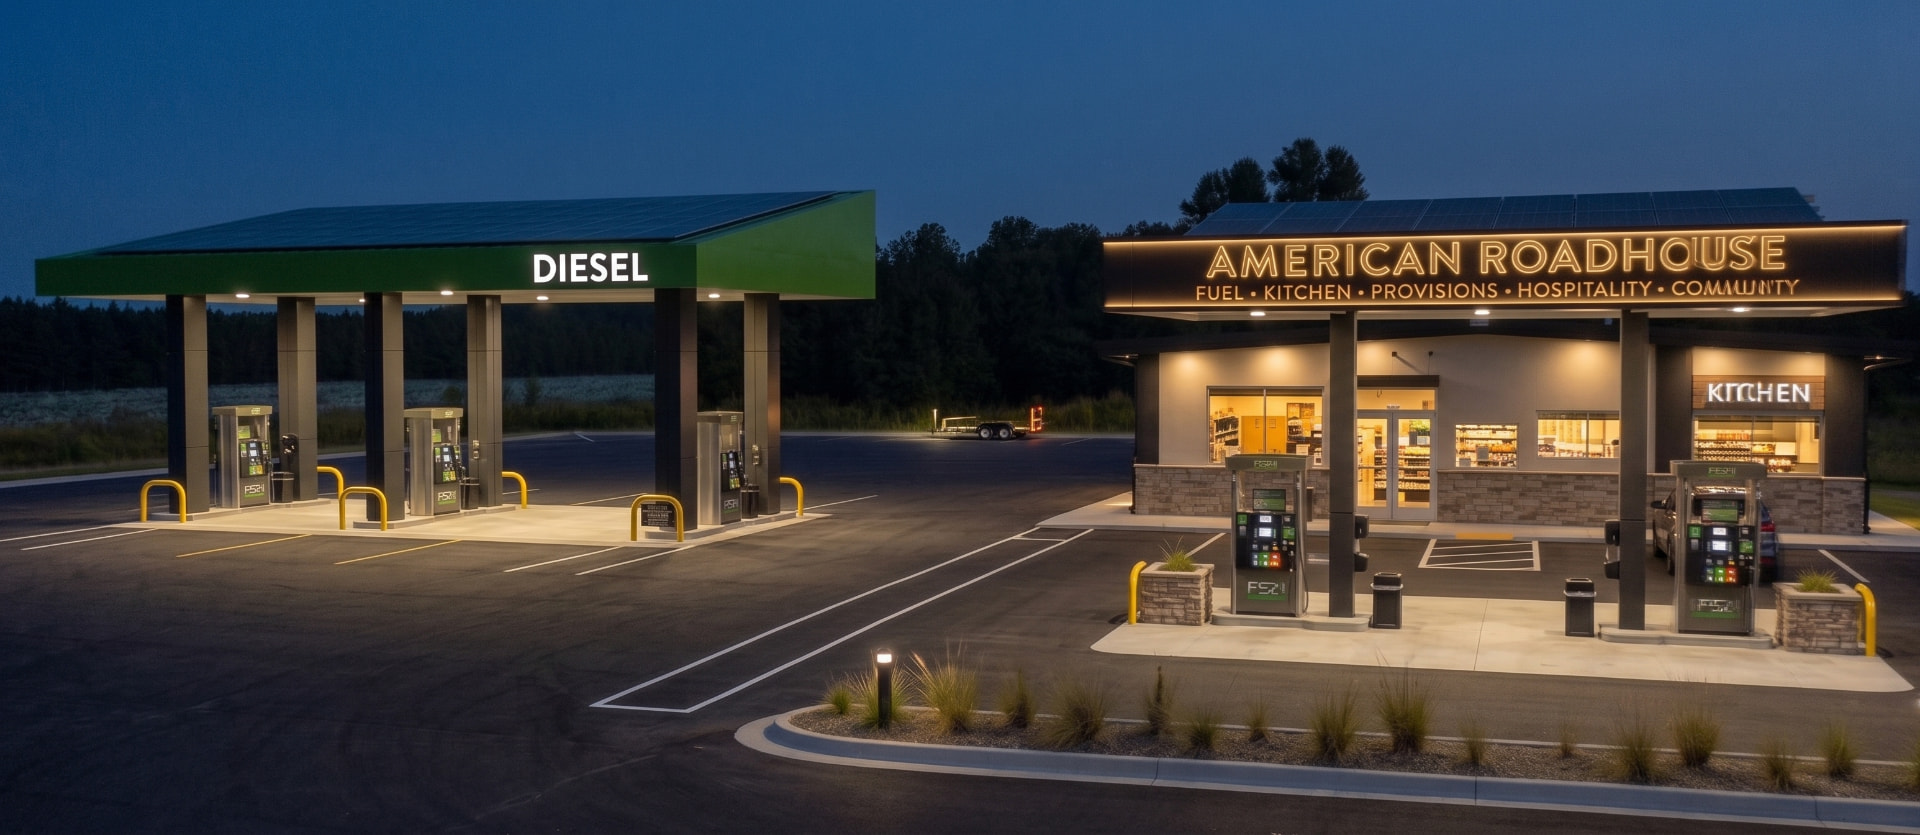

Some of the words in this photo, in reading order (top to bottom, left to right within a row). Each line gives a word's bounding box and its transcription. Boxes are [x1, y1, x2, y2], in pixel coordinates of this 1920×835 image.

[533, 253, 649, 284] DIESEL
[1206, 242, 1460, 279] AMERICAN
[1480, 235, 1786, 275] ROADHOUSE
[1196, 285, 1244, 301] FUEL
[1264, 284, 1351, 300] KITCHEN
[1371, 282, 1498, 300] PROVISIONS
[1517, 280, 1653, 299] HOSPITALITY
